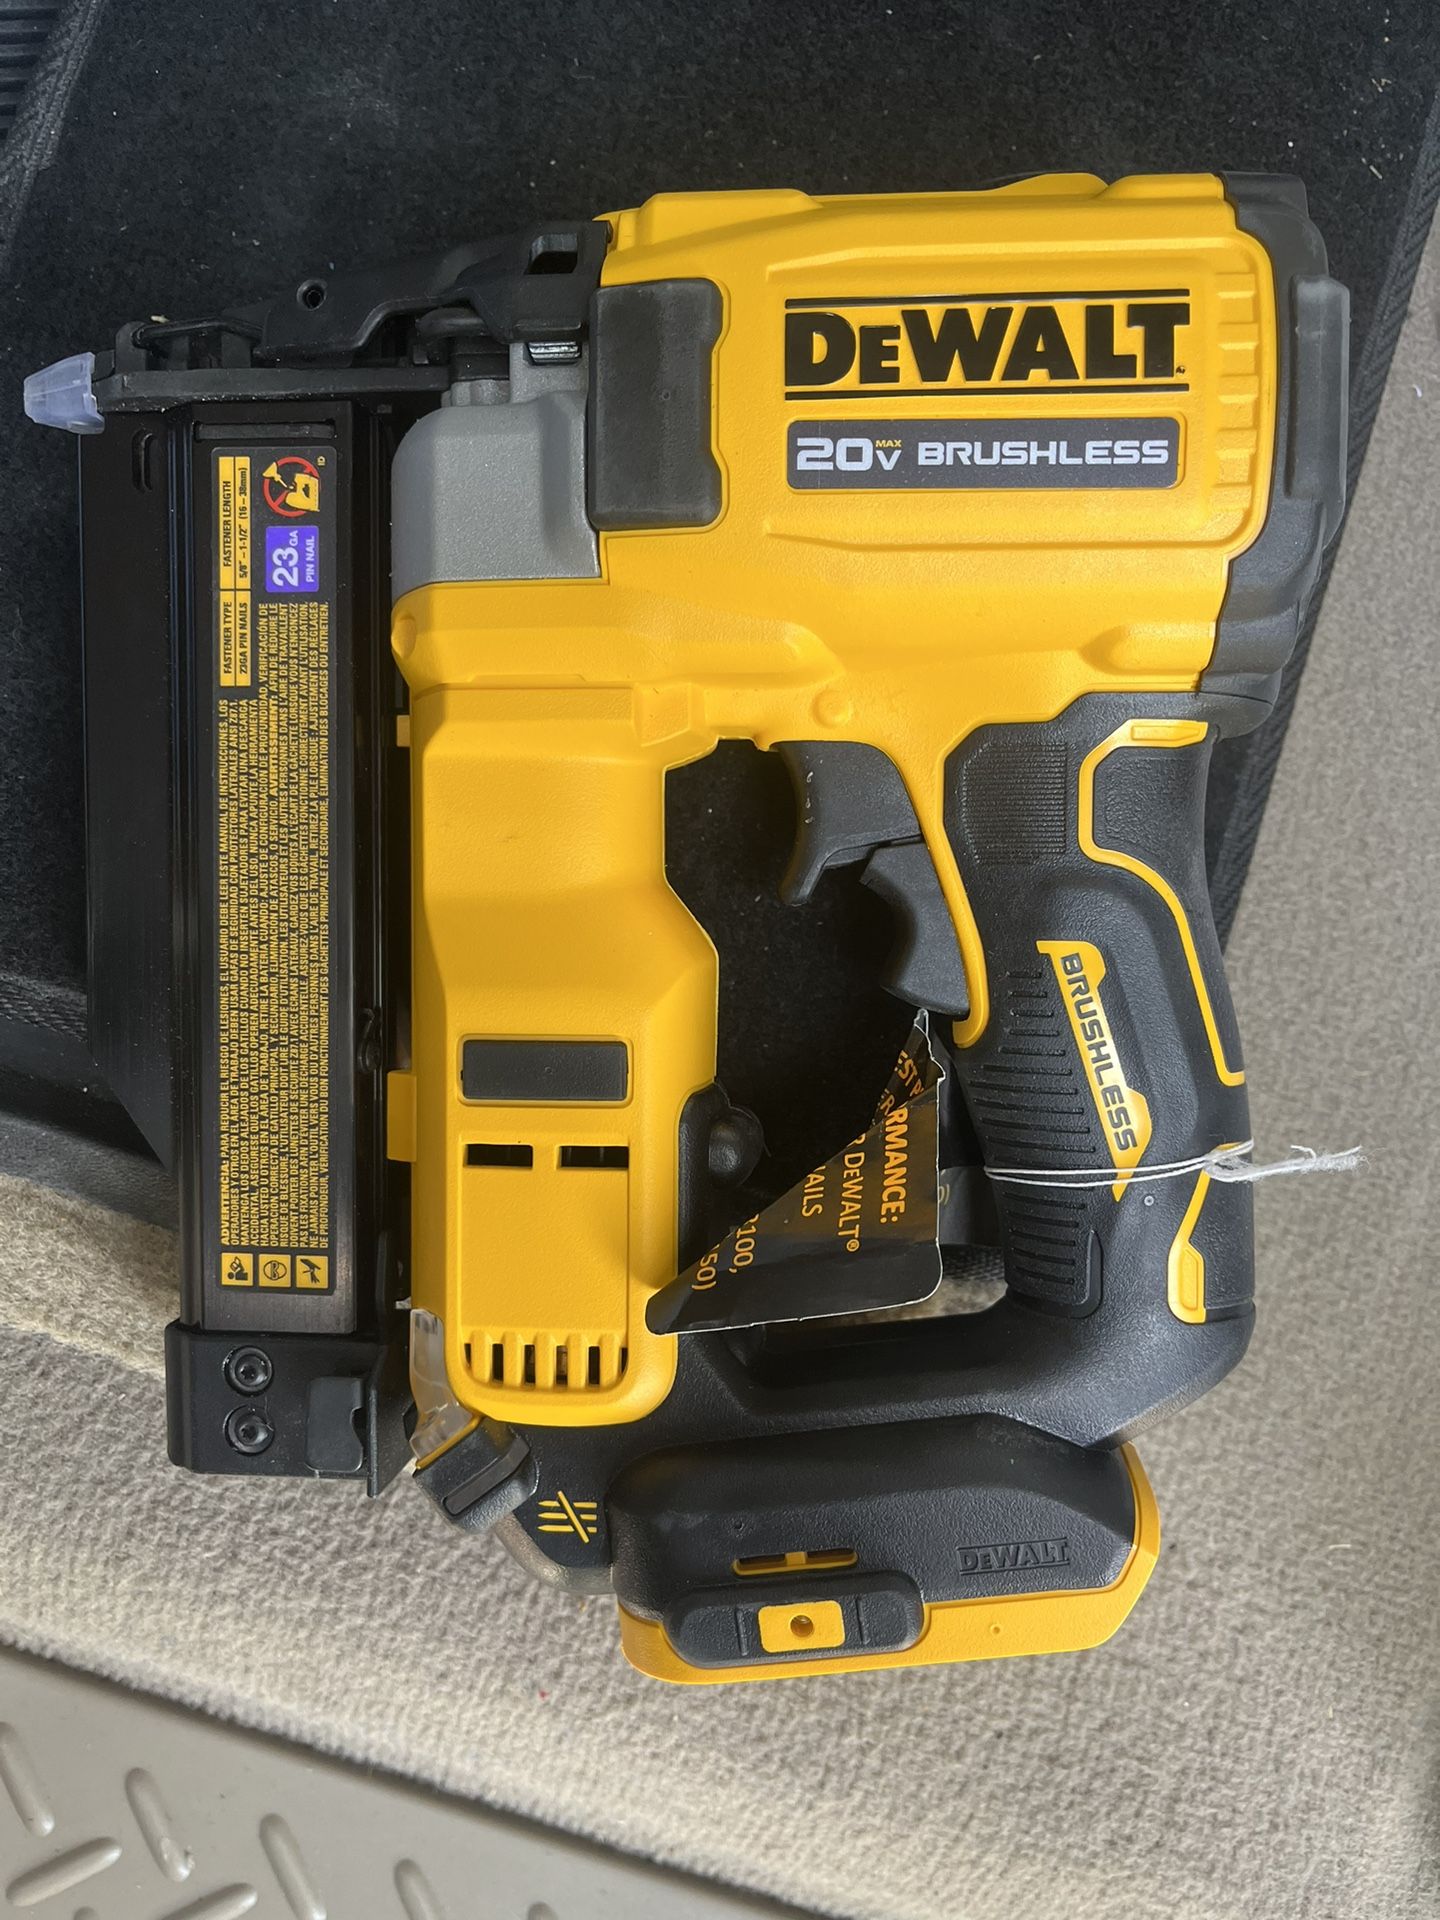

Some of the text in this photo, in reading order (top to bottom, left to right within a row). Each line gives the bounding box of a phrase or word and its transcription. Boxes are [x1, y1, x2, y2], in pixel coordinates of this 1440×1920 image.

[875, 439, 902, 448] MAX
[917, 440, 1169, 465] BRUSHLESS
[222, 481, 232, 567] FASTENER LENGTH
[272, 530, 299, 587] 23 GA
[306, 535, 315, 583] PIN NAIL
[239, 602, 247, 630] NAILS
[279, 603, 287, 662] TRAVAILLENT
[224, 601, 232, 674] FASTENER TYPE
[239, 633, 247, 648] PIN
[269, 669, 278, 692] AFIN
[289, 658, 297, 683] VOUS
[299, 666, 308, 697] AVANT
[289, 684, 298, 723] LORSQUE
[309, 670, 318, 731] AJUSTEMENT
[319, 669, 328, 716] BLOCAGES
[229, 725, 238, 748] ANSI
[249, 699, 258, 766] HERRAMIENTA
[279, 707, 288, 733] DANS
[299, 698, 308, 766] CORRECTEMENT
[229, 749, 238, 798] LATERALES
[279, 734, 288, 789] PERSONNES
[309, 736, 318, 777] LORSQUE
[249, 781, 258, 819] APUNTE
[299, 767, 308, 823] FONCTIONNE
[309, 779, 318, 798] PILE
[279, 790, 288, 826] AUTRES
[219, 810, 228, 852] MANUAL
[229, 800, 238, 863] PROTECTORES
[249, 819, 258, 853] NUNCA
[309, 813, 318, 849] RETIREZ
[219, 854, 228, 876] ESTE
[289, 841, 298, 873] DOIGTS
[219, 878, 228, 900] LEER
[259, 862, 268, 898] AJUSTE
[279, 857, 288, 919] UTILISATEURS
[319, 870, 328, 922] PRINCIPALE
[219, 901, 228, 926] DEBE
[229, 885, 238, 937] SEGURIDAD
[249, 897, 258, 928] ANTES
[289, 894, 298, 928] GARDEZ
[219, 927, 228, 969] USUARIO
[309, 934, 318, 960] DANS
[229, 952, 238, 982] GAFAS
[239, 699, 248, 1246] MANTENGA DEDOS ALEJADOS GATILLOS CUANDO INSERTEN SUJETADORES PARA EVITAR DESCARGA
[249, 929, 258, 1012] ADECUADAMENTE
[230, 983, 238, 1008] USAR
[310, 961, 318, 1015] PERSONNES
[230, 1009, 238, 1039] DEBEN
[250, 1012, 258, 1048] OPEREN
[260, 998, 268, 1029] RETIRE
[280, 1006, 288, 1033] GUIDE
[290, 1013, 298, 1037] AVEC
[290, 1037, 298, 1058] Z87.1
[320, 996, 328, 1076] FONCTIONNEMENT
[1060, 953, 1138, 1151] BRUSHLESS
[220, 1045, 228, 1078] RIESGO
[230, 1041, 238, 1082] TRABAJO
[250, 1050, 258, 1093] GATILLOS
[270, 1047, 278, 1093] PRINCIPAL
[280, 1046, 288, 1065] LIRE
[280, 1068, 288, 1088] DOIT
[310, 1076, 318, 1101] VOUS
[220, 1092, 228, 1131] REDUCIR
[270, 1095, 278, 1132] GATILLO
[310, 1102, 318, 1125] VERS
[220, 1133, 228, 1157] PARA
[290, 1114, 298, 1156] LUNETTES
[230, 1148, 238, 1178] OTROS
[260, 1145, 268, 1176] OTROS
[270, 1147, 278, 1193] CORRECTA
[300, 1146, 308, 1168] AFIN
[880, 1101, 908, 1223] RMANCE:
[290, 1176, 298, 1209] PORTER
[300, 1168, 308, 1212] FIXATIONS
[310, 1159, 318, 1198] POINTER
[802, 1165, 826, 1217] AILS
[230, 1187, 238, 1245] OPERADORES
[260, 1186, 268, 1216] USTED
[310, 1199, 318, 1234] JAMAIS
[260, 1217, 268, 1246] HACIA
[280, 1215, 288, 1247] RISQUE
[290, 1211, 298, 1247] DOIVENT
[692, 1244, 720, 1290] 50)
[957, 1539, 1069, 1572] DEWALT
